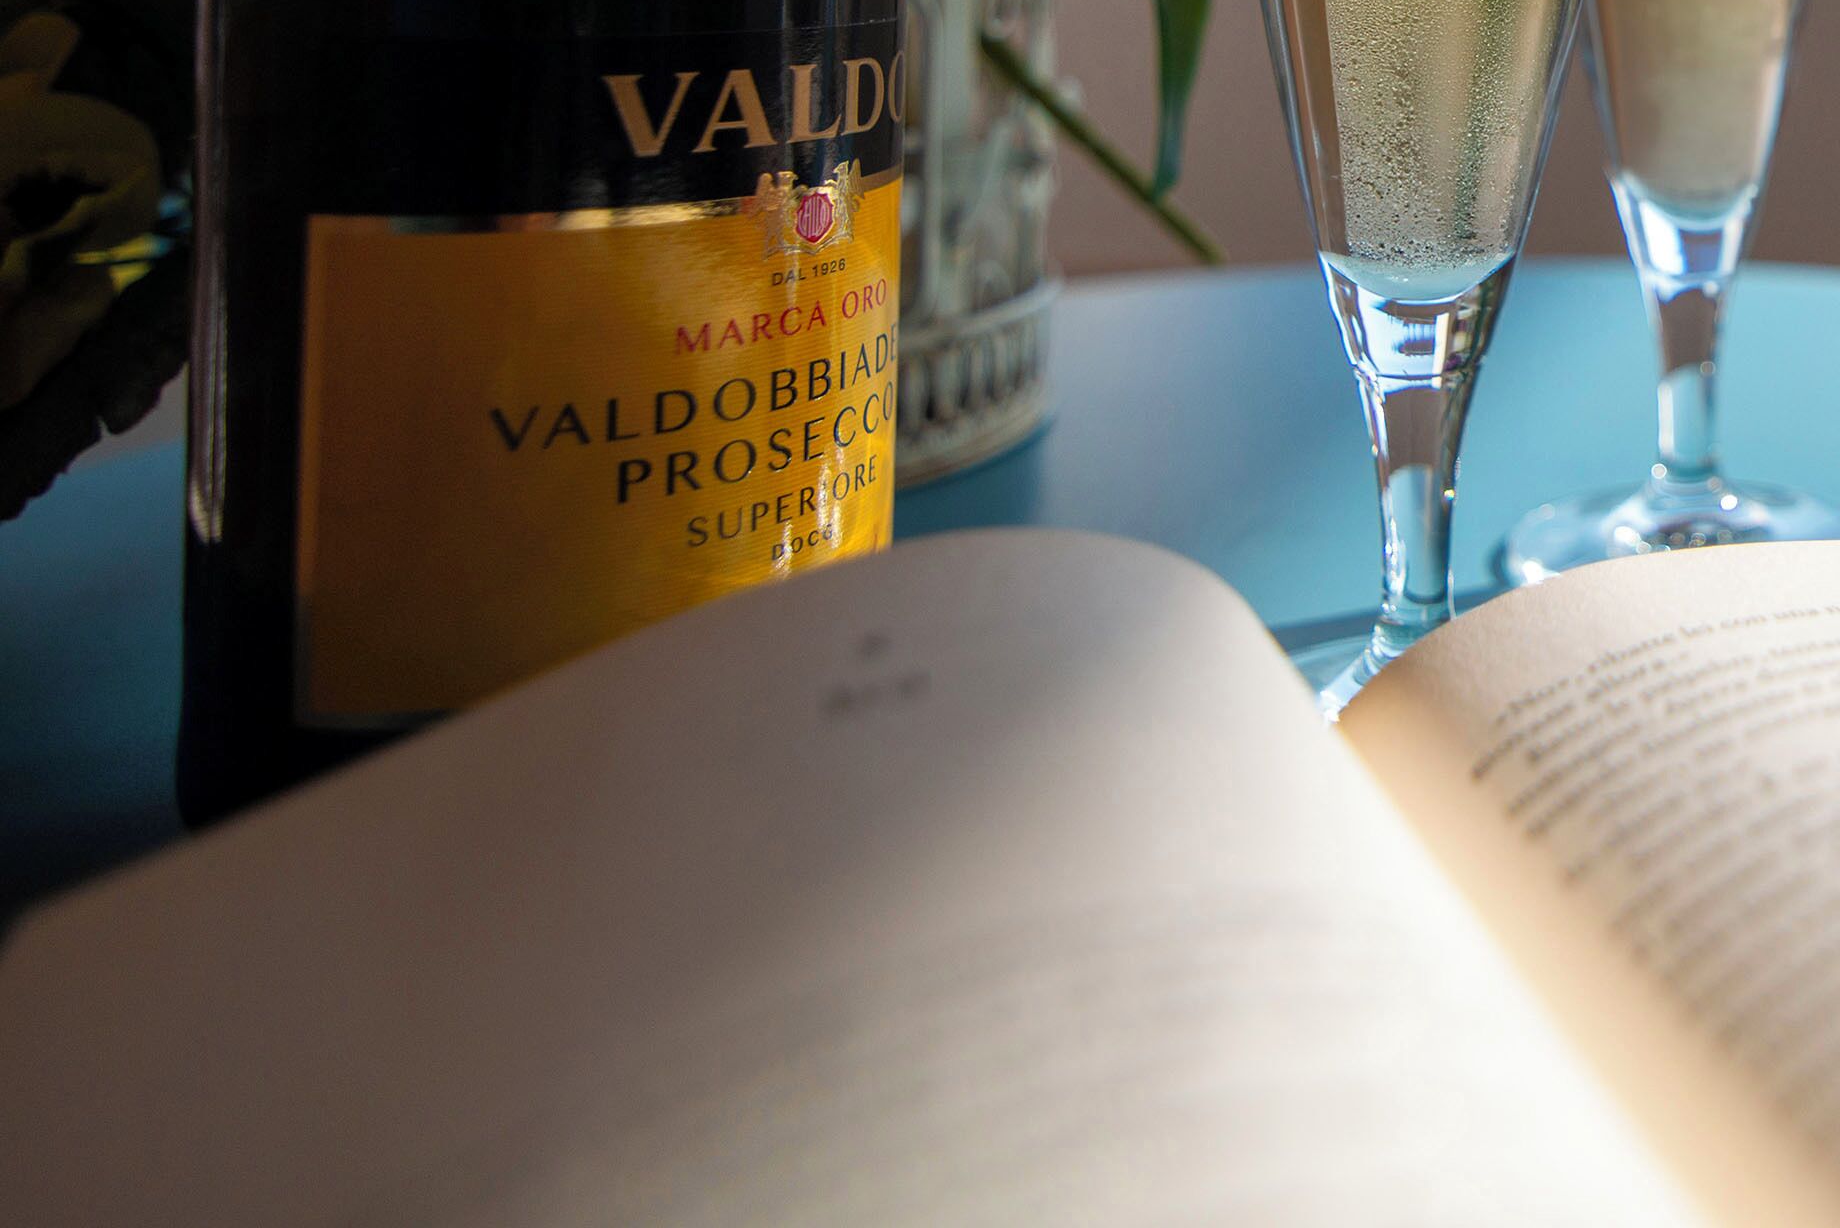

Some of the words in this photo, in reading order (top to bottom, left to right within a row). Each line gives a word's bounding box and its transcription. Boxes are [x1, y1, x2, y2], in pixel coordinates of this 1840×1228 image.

[771, 268, 807, 287] DAL
[812, 257, 846, 278] 1926
[674, 300, 828, 355] MARCA
[841, 278, 888, 319] ORO
[614, 380, 894, 505] PROSECCO
